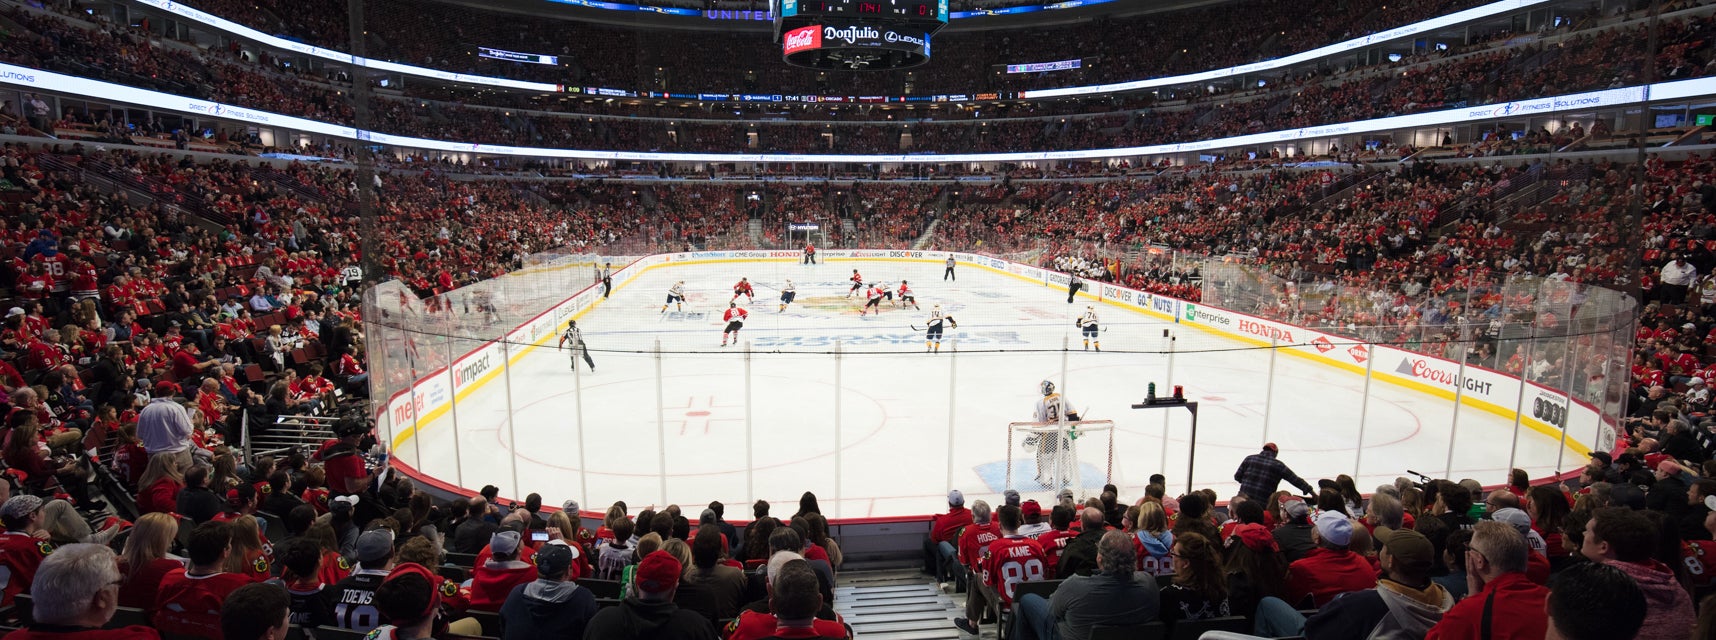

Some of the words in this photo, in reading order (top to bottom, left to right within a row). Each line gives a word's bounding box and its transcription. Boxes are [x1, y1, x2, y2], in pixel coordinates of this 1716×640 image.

[898, 35, 925, 46] LEXUS
[1522, 103, 1551, 111] FITNESS
[1554, 97, 1600, 107] SOLUTIONS
[348, 268, 359, 278] 19
[1104, 286, 1132, 302] DISCOVER
[1153, 297, 1173, 313] NUTS!
[1188, 308, 1230, 325] enterprise
[1238, 319, 1294, 343] HONDA
[460, 354, 490, 385] impact
[1412, 359, 1453, 385] Coors
[1454, 374, 1493, 396] LIGHT
[1008, 545, 1032, 558] KANE
[341, 588, 375, 605] TOEWS
